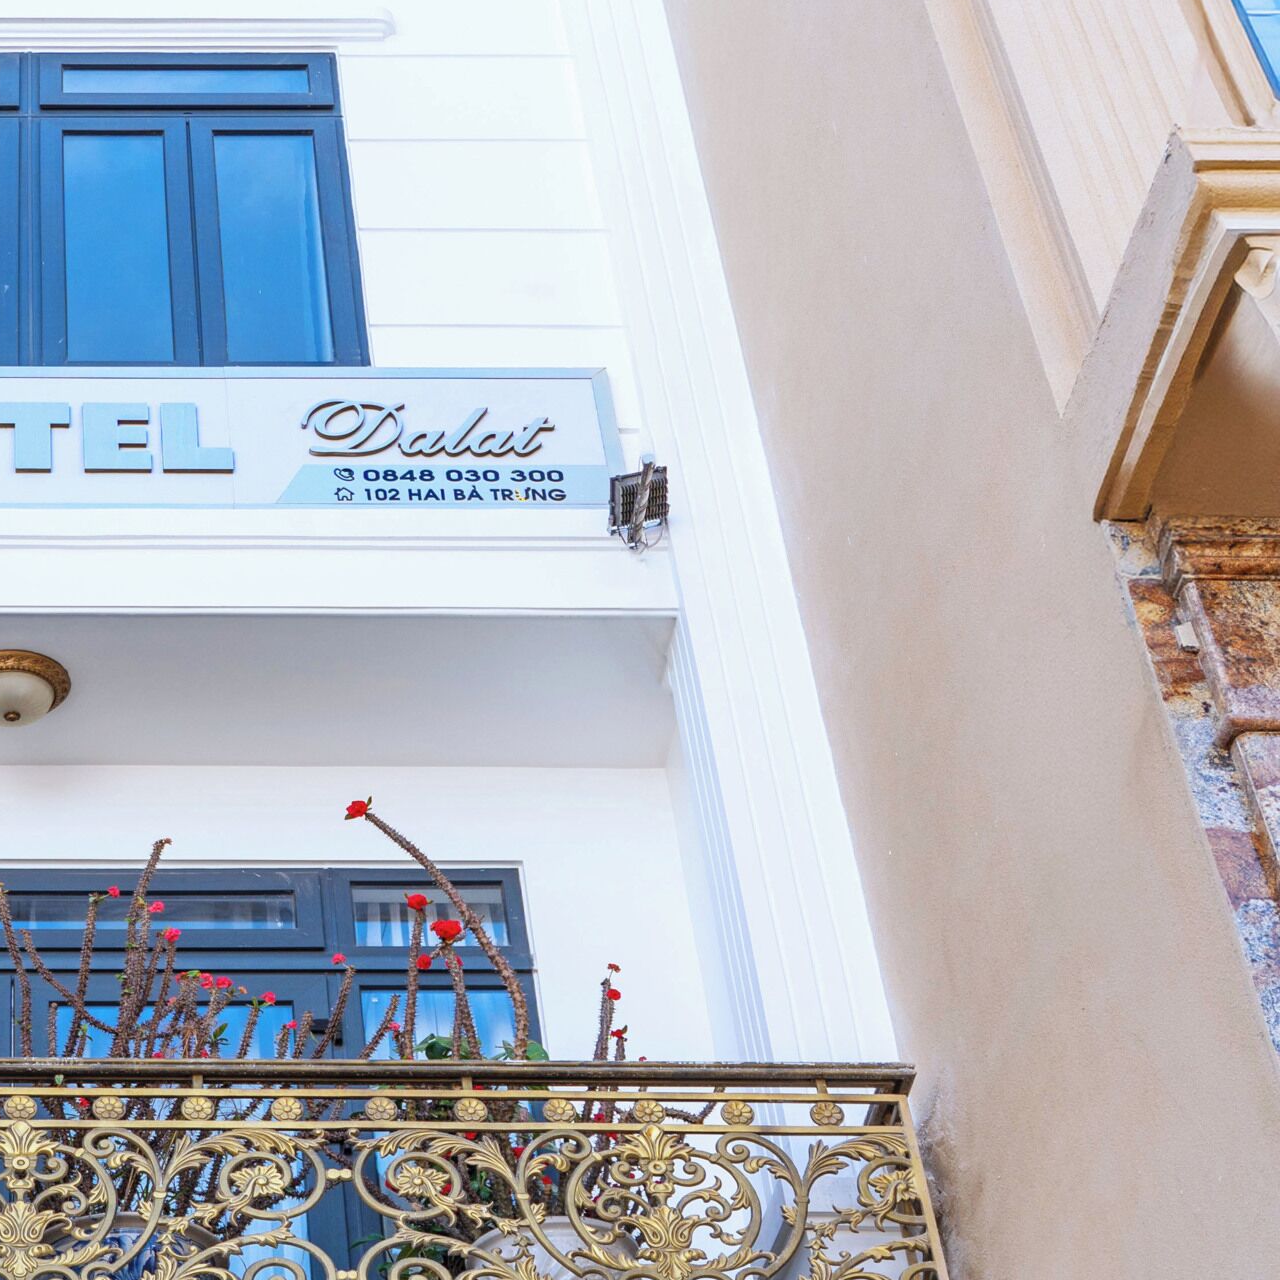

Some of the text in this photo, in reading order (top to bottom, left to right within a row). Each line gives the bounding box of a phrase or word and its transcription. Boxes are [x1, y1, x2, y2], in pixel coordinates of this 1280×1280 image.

[301, 398, 556, 458] Dalat
[363, 469, 564, 483] 0848 030 300
[364, 488, 401, 502] 102
[407, 488, 447, 502] HAI
[454, 485, 484, 502] BÀ
